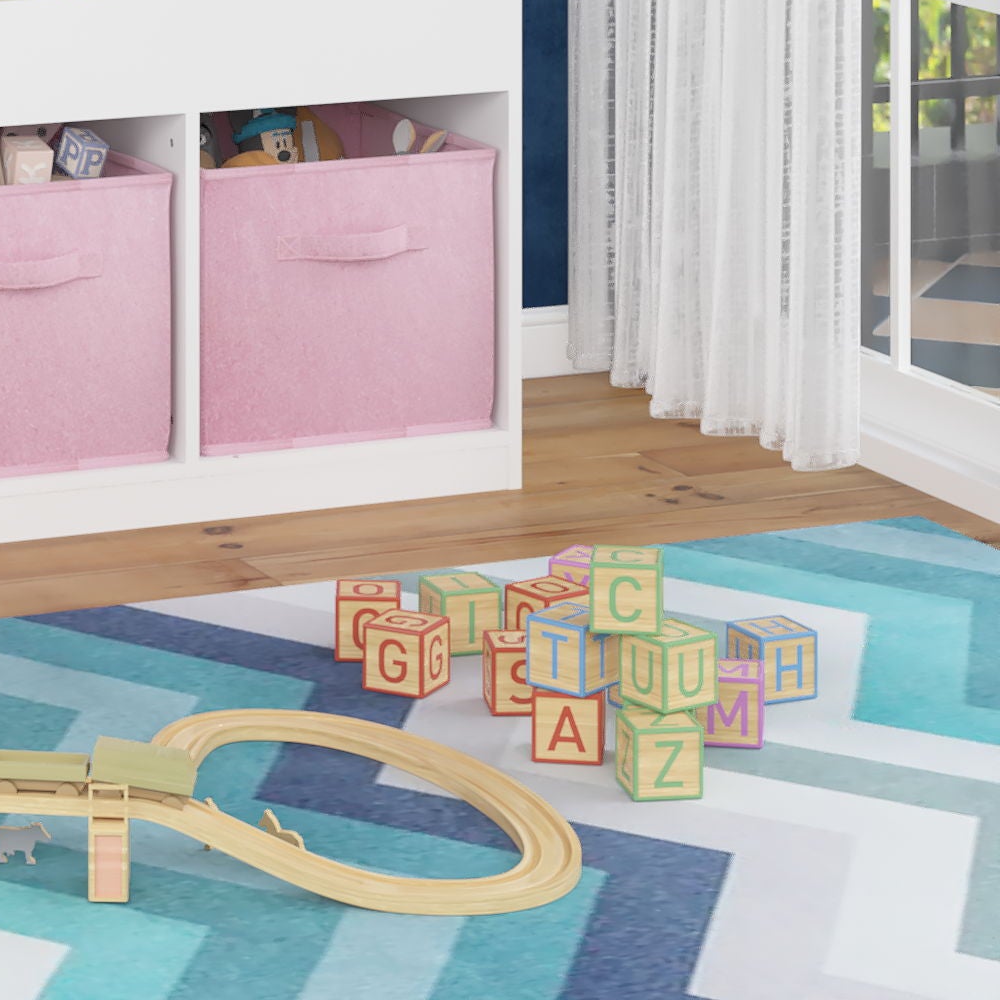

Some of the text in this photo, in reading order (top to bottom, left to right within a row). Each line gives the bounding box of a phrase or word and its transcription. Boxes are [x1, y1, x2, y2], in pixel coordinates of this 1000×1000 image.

[62, 134, 79, 165] P
[80, 150, 103, 175] P
[609, 576, 642, 623] C
[378, 639, 408, 684] G
[429, 635, 443, 680] G
[541, 631, 568, 680] T
[632, 644, 654, 695] U
[678, 648, 704, 697] U
[776, 645, 803, 692] H
[547, 706, 586, 753] A
[707, 690, 748, 736] M
[654, 740, 684, 789] Z
